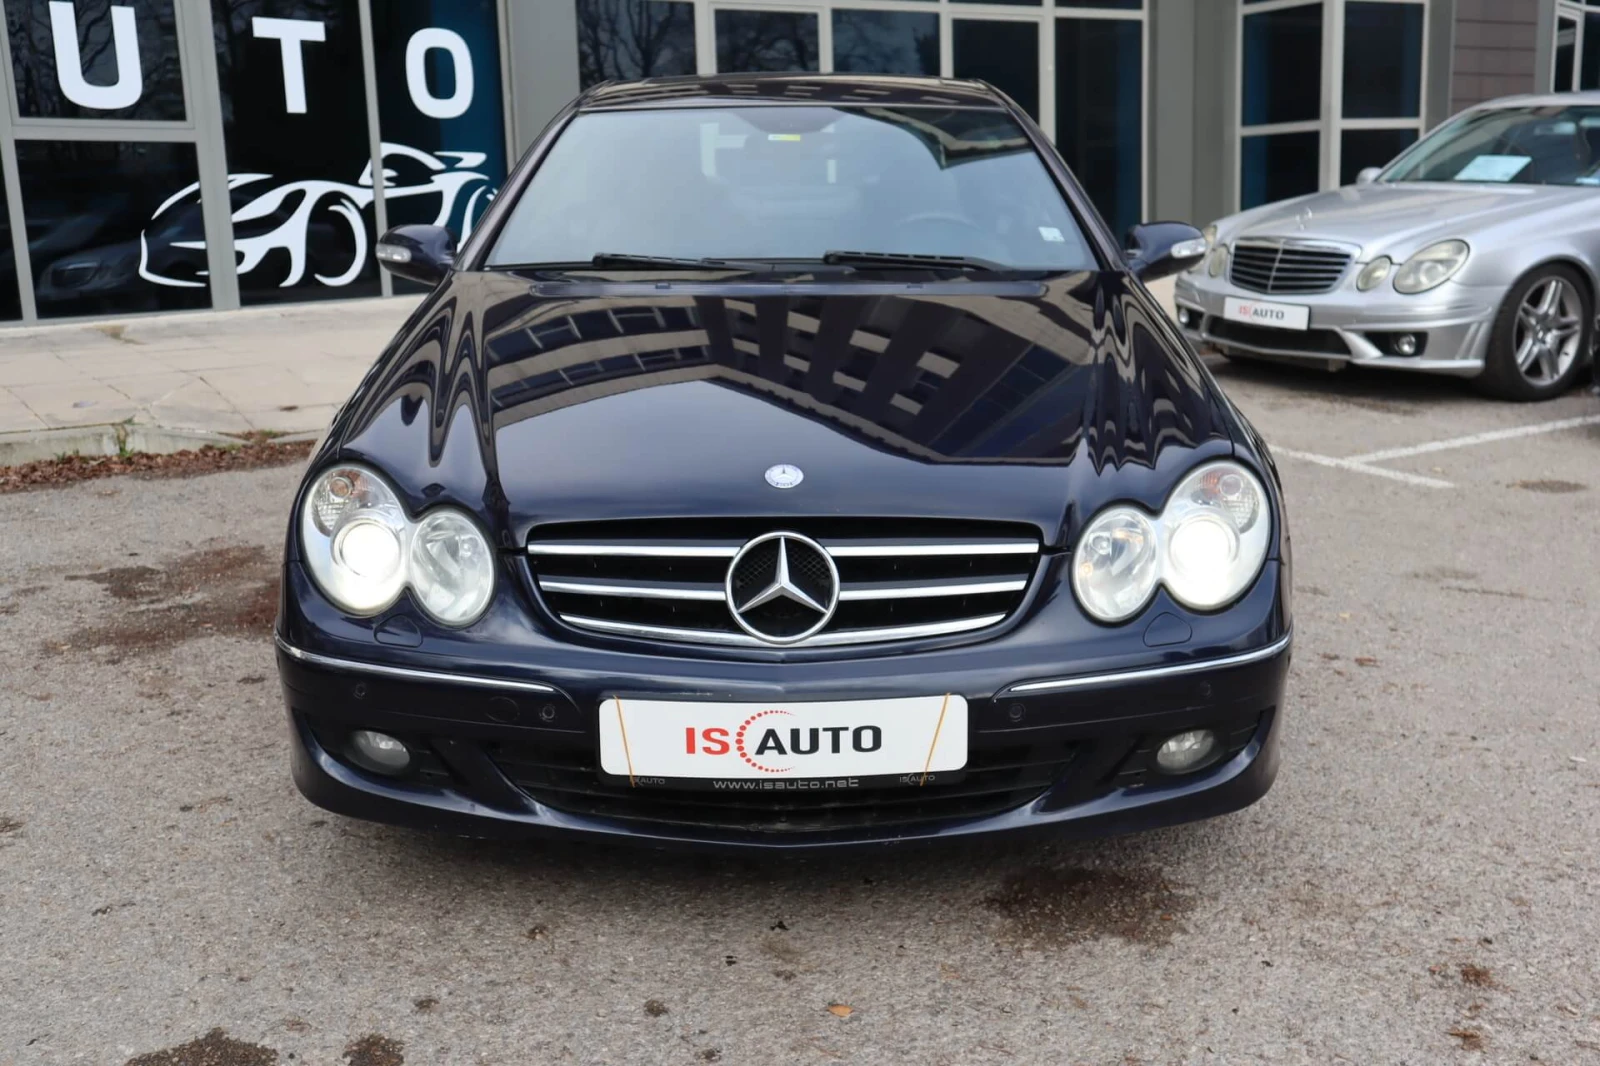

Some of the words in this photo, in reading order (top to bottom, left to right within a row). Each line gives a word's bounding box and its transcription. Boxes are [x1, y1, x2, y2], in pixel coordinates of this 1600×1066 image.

[1252, 307, 1285, 320] AUTO
[685, 727, 730, 756] IS
[754, 725, 882, 756] AUTO
[712, 777, 860, 790] www.isauto.net
